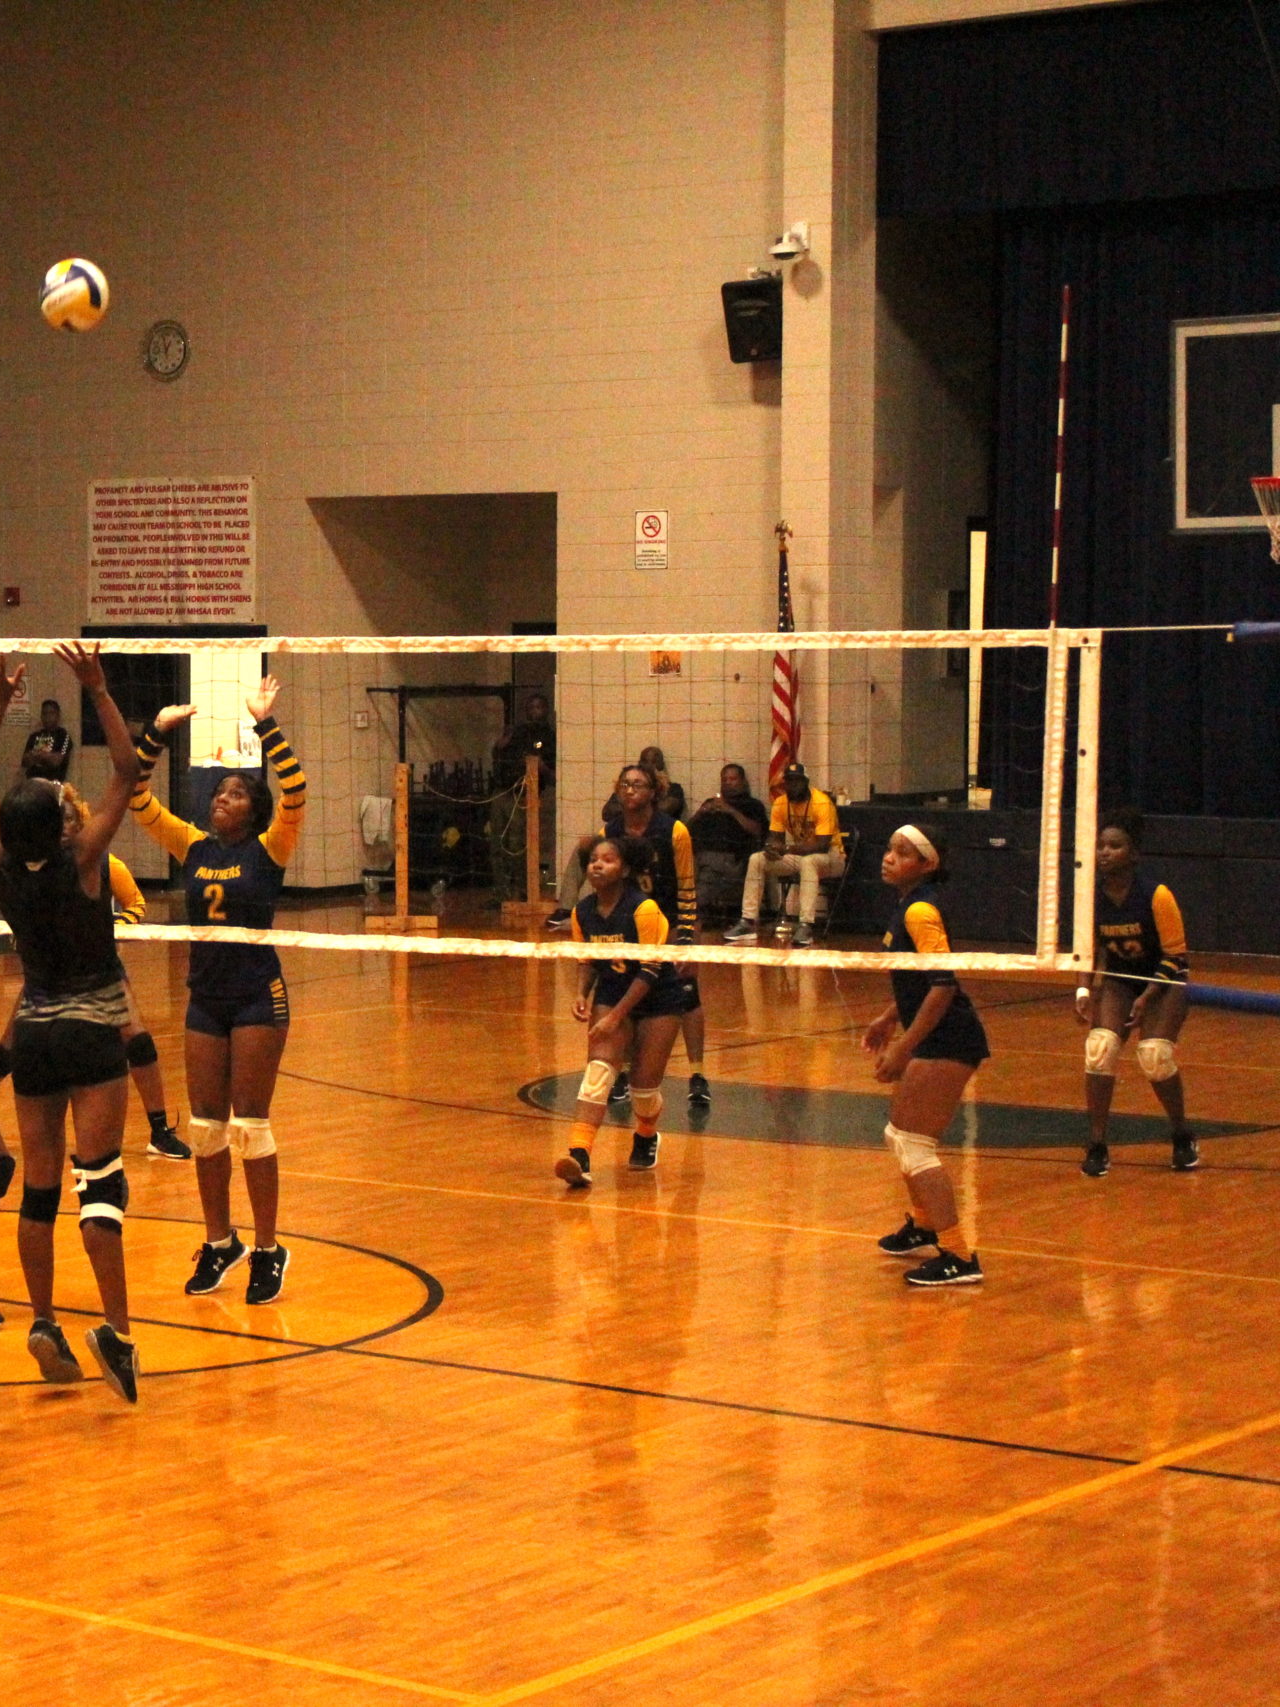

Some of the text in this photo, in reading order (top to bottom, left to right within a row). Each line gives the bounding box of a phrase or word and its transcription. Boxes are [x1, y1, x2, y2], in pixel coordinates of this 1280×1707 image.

[130, 486, 144, 494] AND
[198, 484, 210, 492] ARE
[158, 497, 172, 505] AND
[197, 496, 235, 504] REFLECTION
[213, 508, 249, 516] BEHAVIOR
[121, 559, 135, 567] AND
[199, 570, 229, 578] TOBACCO
[194, 864, 241, 880] PANTHERS
[203, 883, 226, 920] 2
